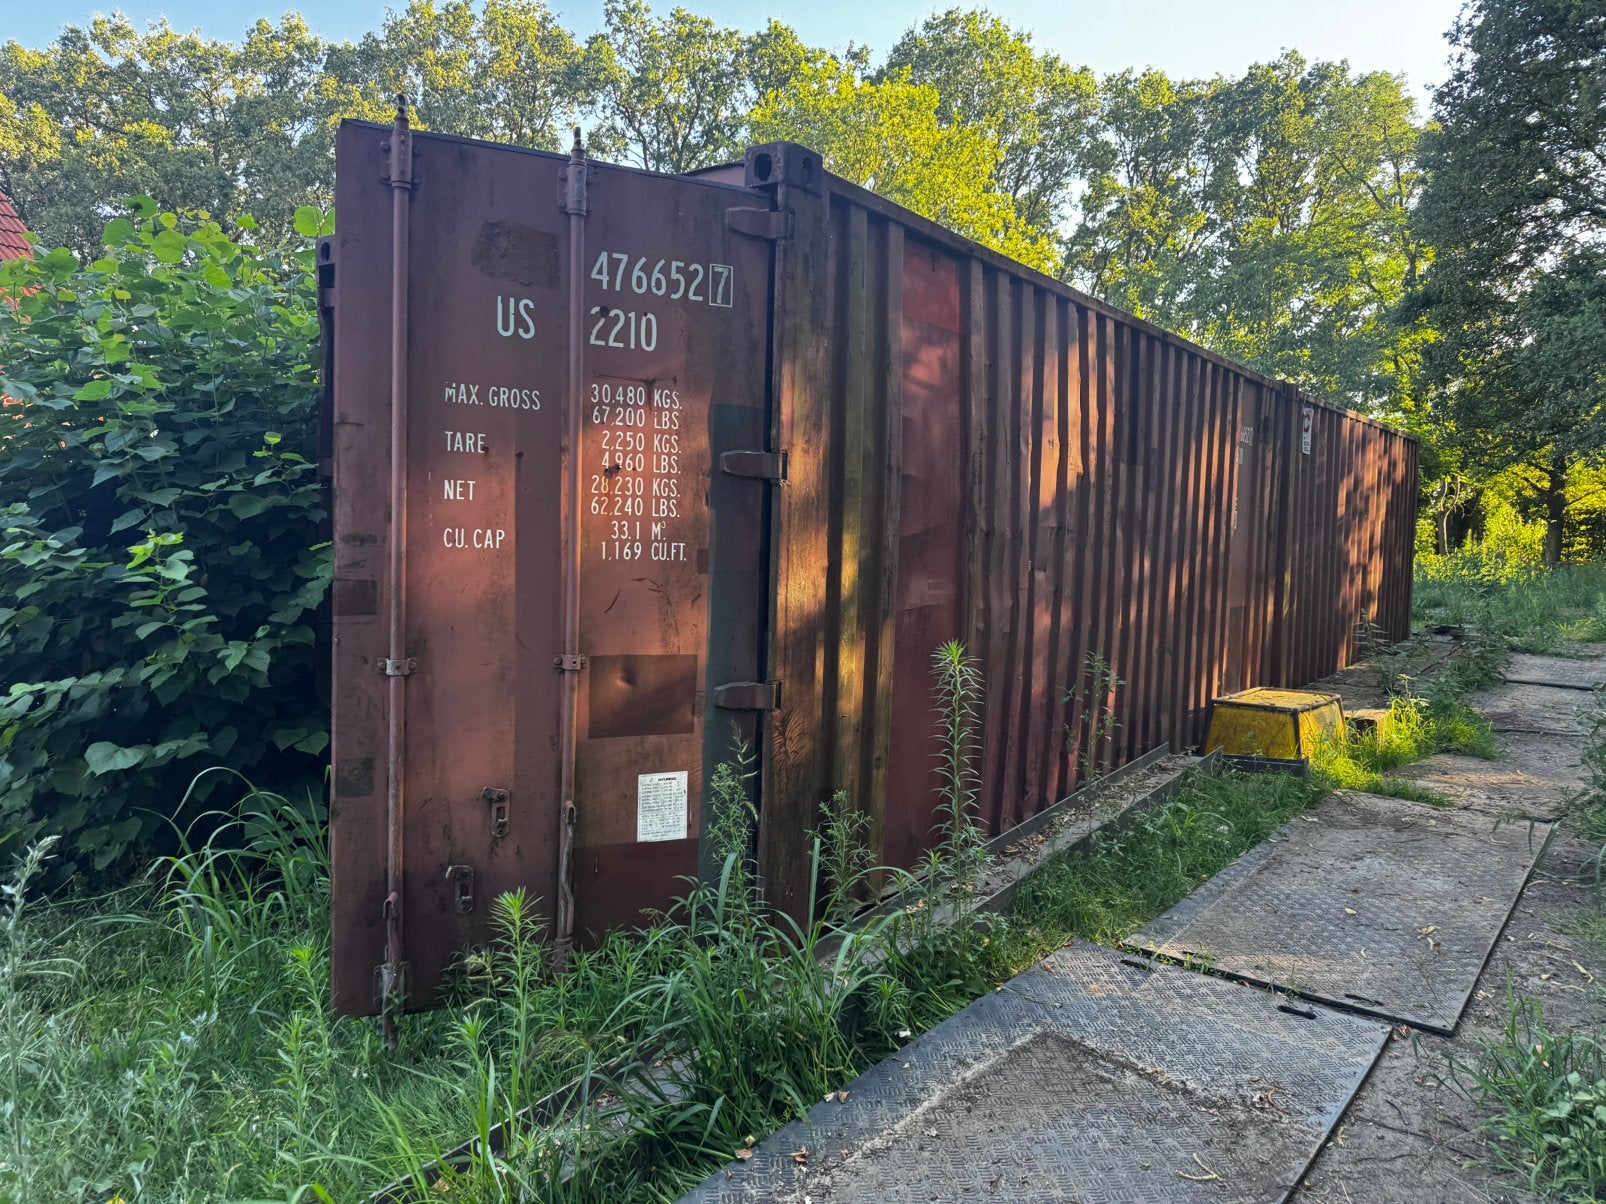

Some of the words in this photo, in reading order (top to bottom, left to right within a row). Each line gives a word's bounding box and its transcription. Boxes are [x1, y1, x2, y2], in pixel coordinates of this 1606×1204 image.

[497, 295, 536, 339] US
[590, 306, 658, 352] 2210
[444, 382, 484, 406] MAX.
[488, 386, 541, 410] GROSS
[653, 388, 683, 410] KGS.
[592, 405, 646, 428] 67,200
[444, 431, 486, 454] TARE
[601, 430, 645, 452] 2,250
[653, 433, 682, 454] KGS.
[653, 454, 682, 474] LBS.
[443, 479, 477, 501] NET
[591, 475, 644, 496] 28,230
[652, 477, 681, 498] KGS.
[591, 496, 644, 516] 62,240
[652, 498, 680, 518] LBS.
[443, 527, 469, 549] CU.
[473, 528, 506, 550] CAP
[610, 520, 641, 540] 33.1
[601, 541, 643, 561] 1,169
[651, 542, 687, 562] CU.FT.
